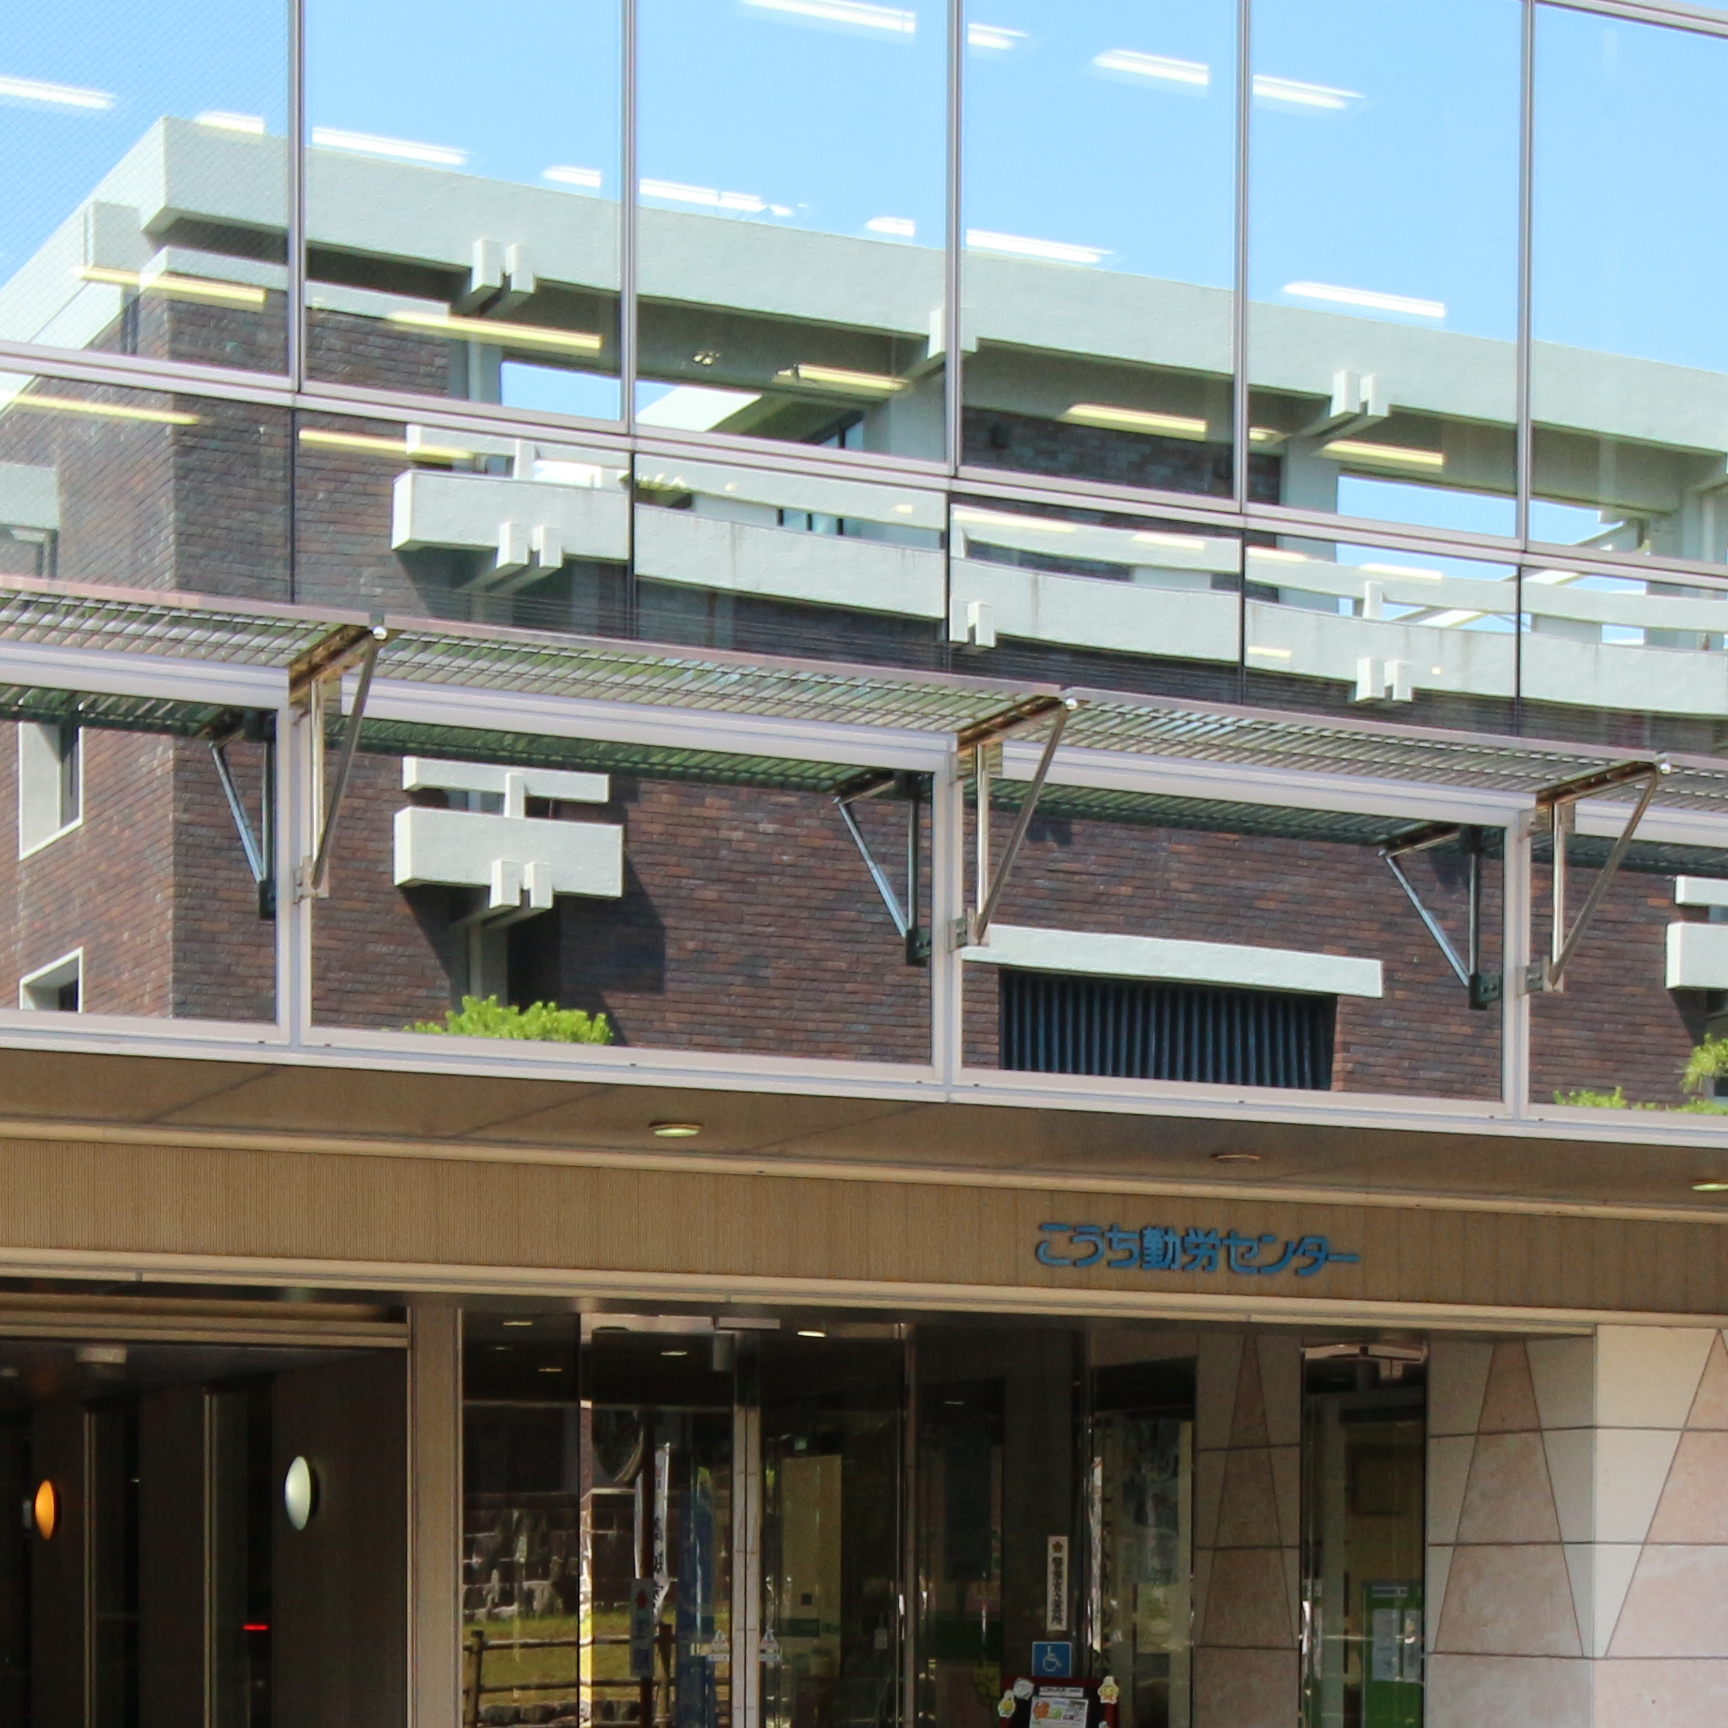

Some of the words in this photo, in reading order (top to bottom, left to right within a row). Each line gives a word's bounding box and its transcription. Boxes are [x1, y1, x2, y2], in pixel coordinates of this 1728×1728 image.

[1036, 1223, 1360, 1276] こうち勤労センター
